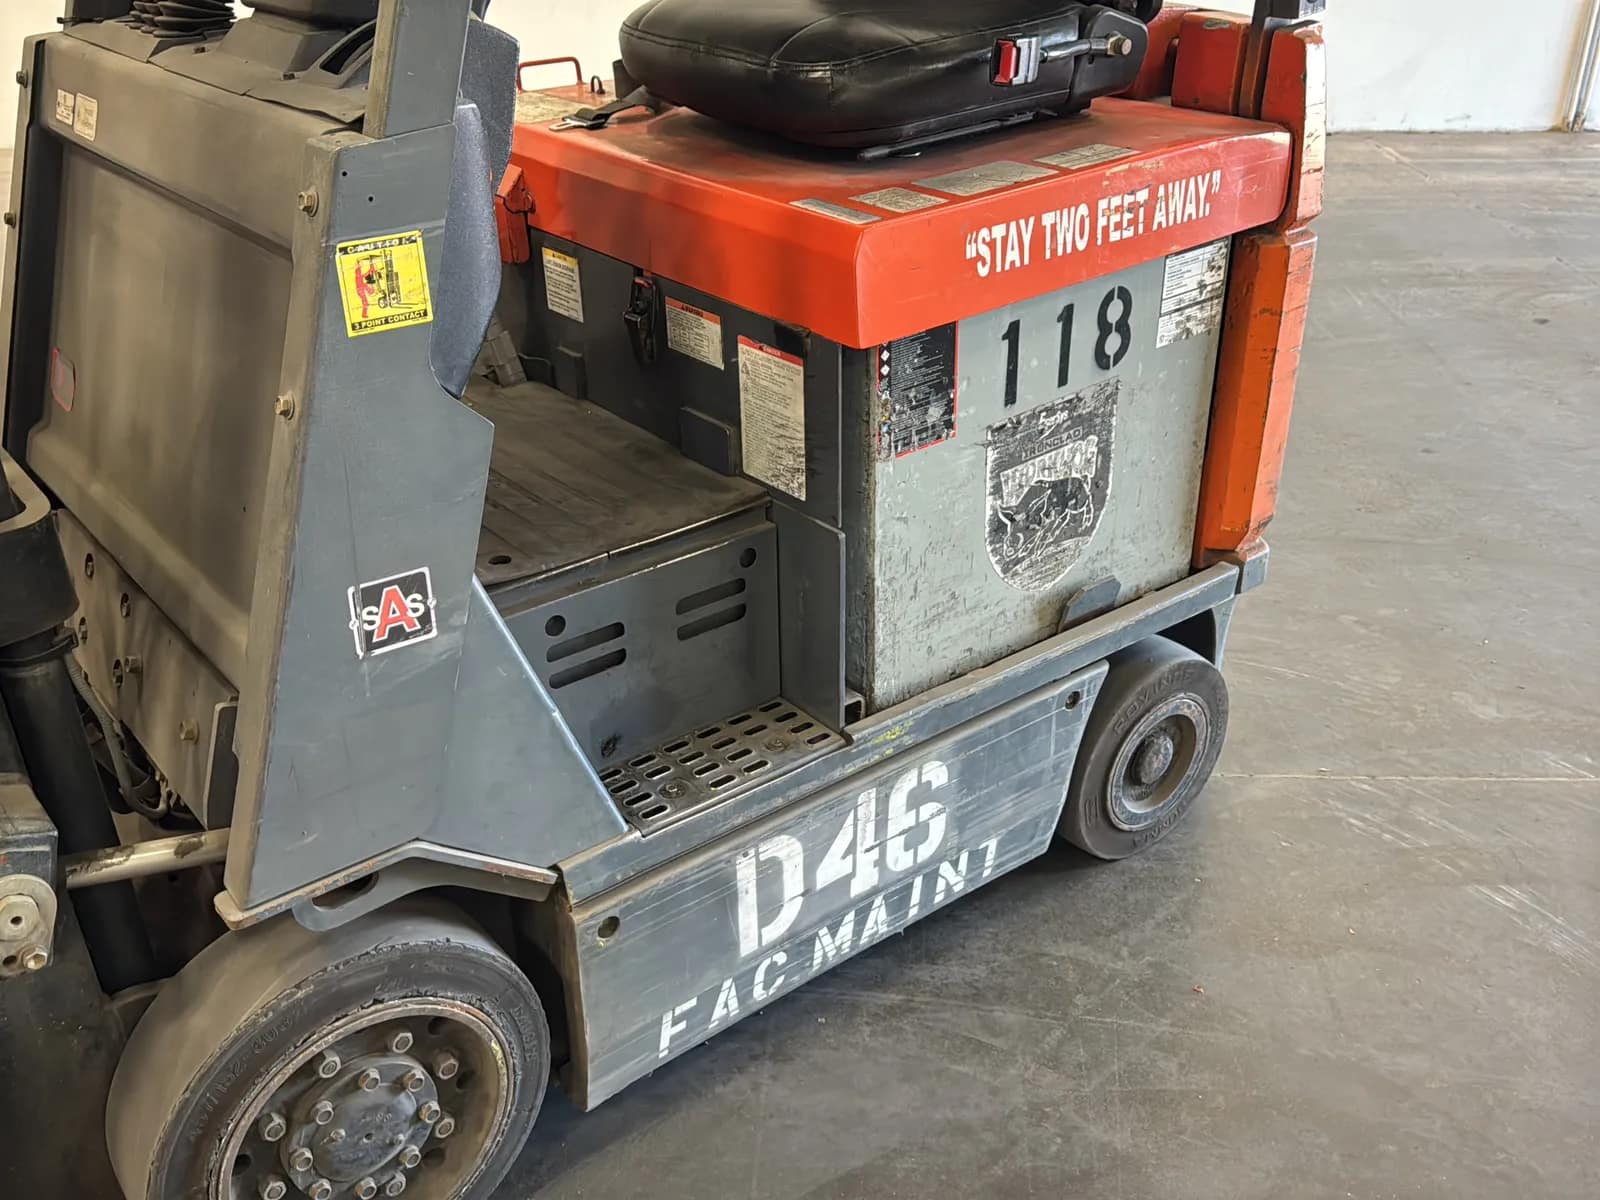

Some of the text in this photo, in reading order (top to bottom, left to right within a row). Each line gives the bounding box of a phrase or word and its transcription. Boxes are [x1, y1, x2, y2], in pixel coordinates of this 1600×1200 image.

[1042, 203, 1090, 260] TWO
[1097, 188, 1149, 245] FEET
[361, 318, 386, 328] POINT
[388, 310, 425, 323] CONTACT
[1001, 285, 1133, 408] 118
[735, 760, 949, 957] D46
[659, 951, 788, 1058] FAC
